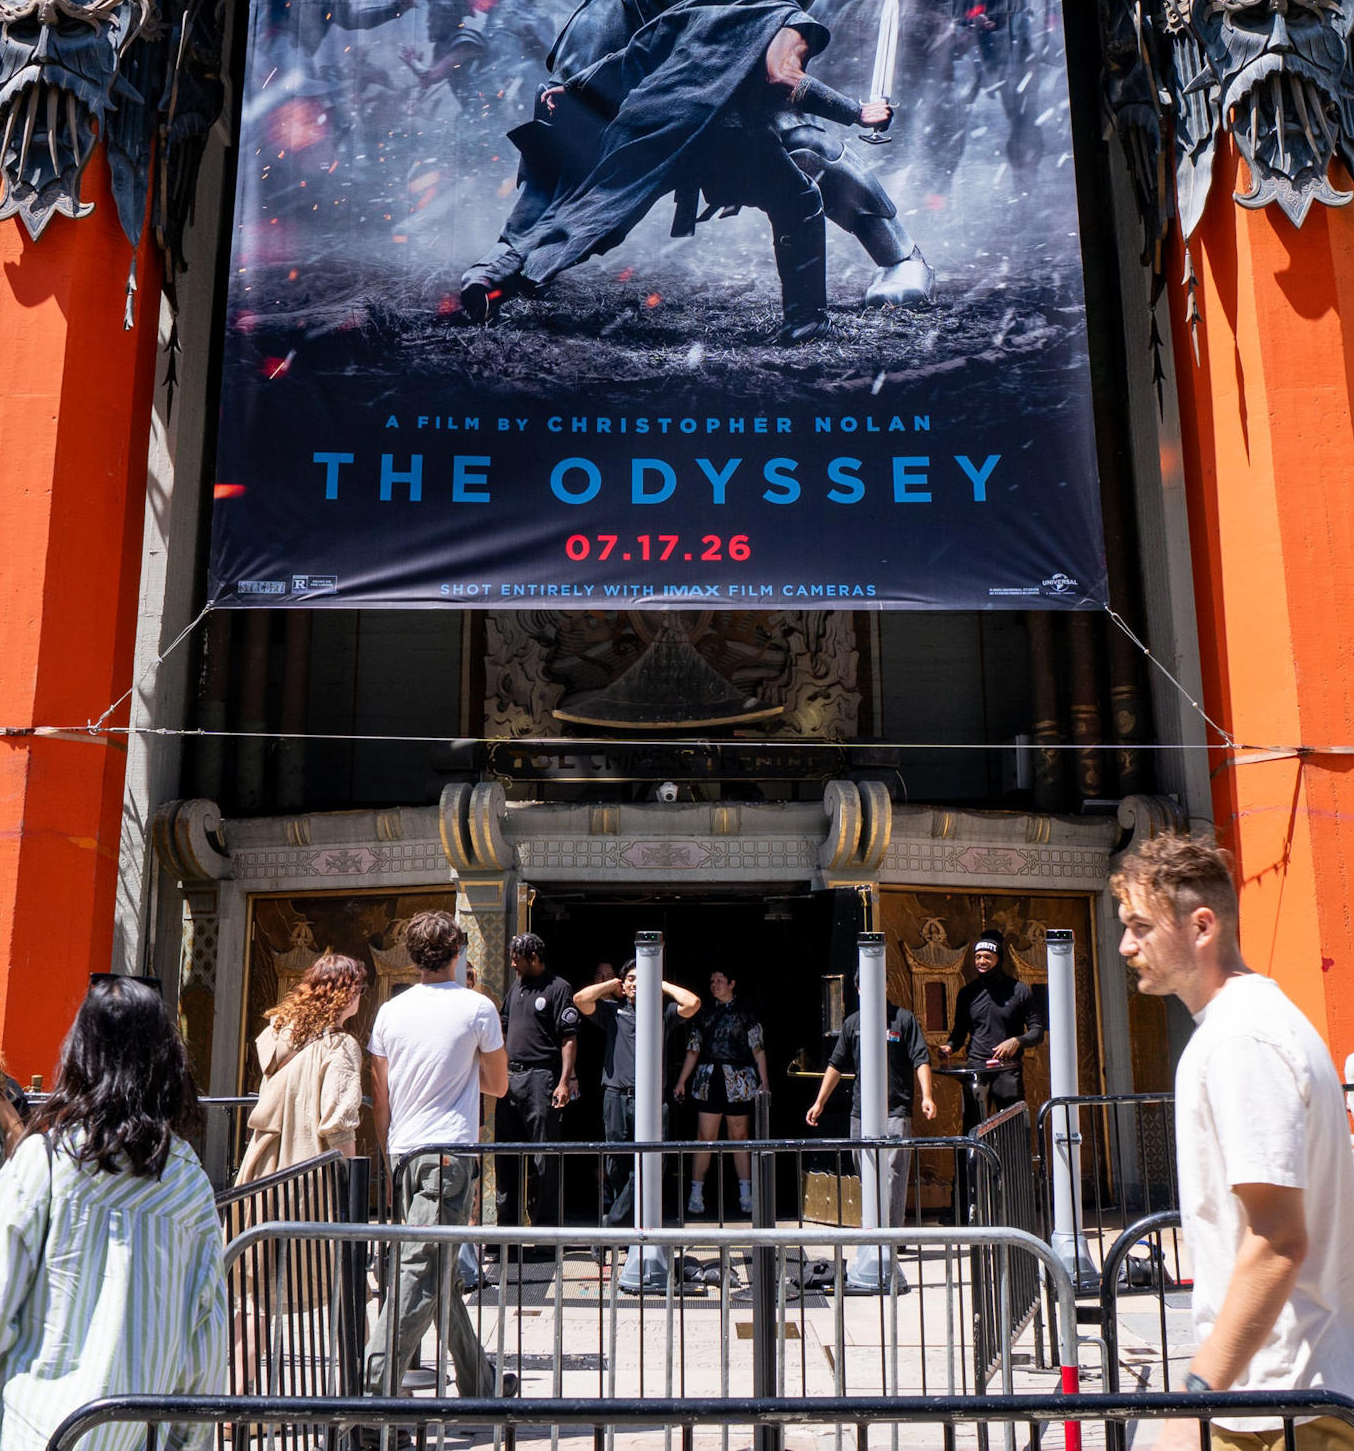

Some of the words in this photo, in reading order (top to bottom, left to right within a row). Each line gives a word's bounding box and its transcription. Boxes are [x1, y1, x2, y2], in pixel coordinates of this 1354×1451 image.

[385, 415, 401, 431] A
[416, 415, 481, 432] FILM
[497, 416, 531, 432] BY
[547, 415, 794, 434] CHRISTOPHER
[813, 414, 934, 433] NOLAN
[313, 451, 492, 504] THE
[549, 453, 1004, 505] ODYSSEY
[565, 534, 753, 562] 07.17.26
[294, 579, 307, 589] R
[440, 583, 492, 596] SHOT
[500, 584, 595, 597] ENTIRELY
[603, 584, 654, 597] WITH
[663, 585, 721, 597] IMAX
[728, 584, 774, 597] FILM
[782, 584, 877, 597] CAMERAS
[1042, 578, 1079, 586] UNIVERSAL
